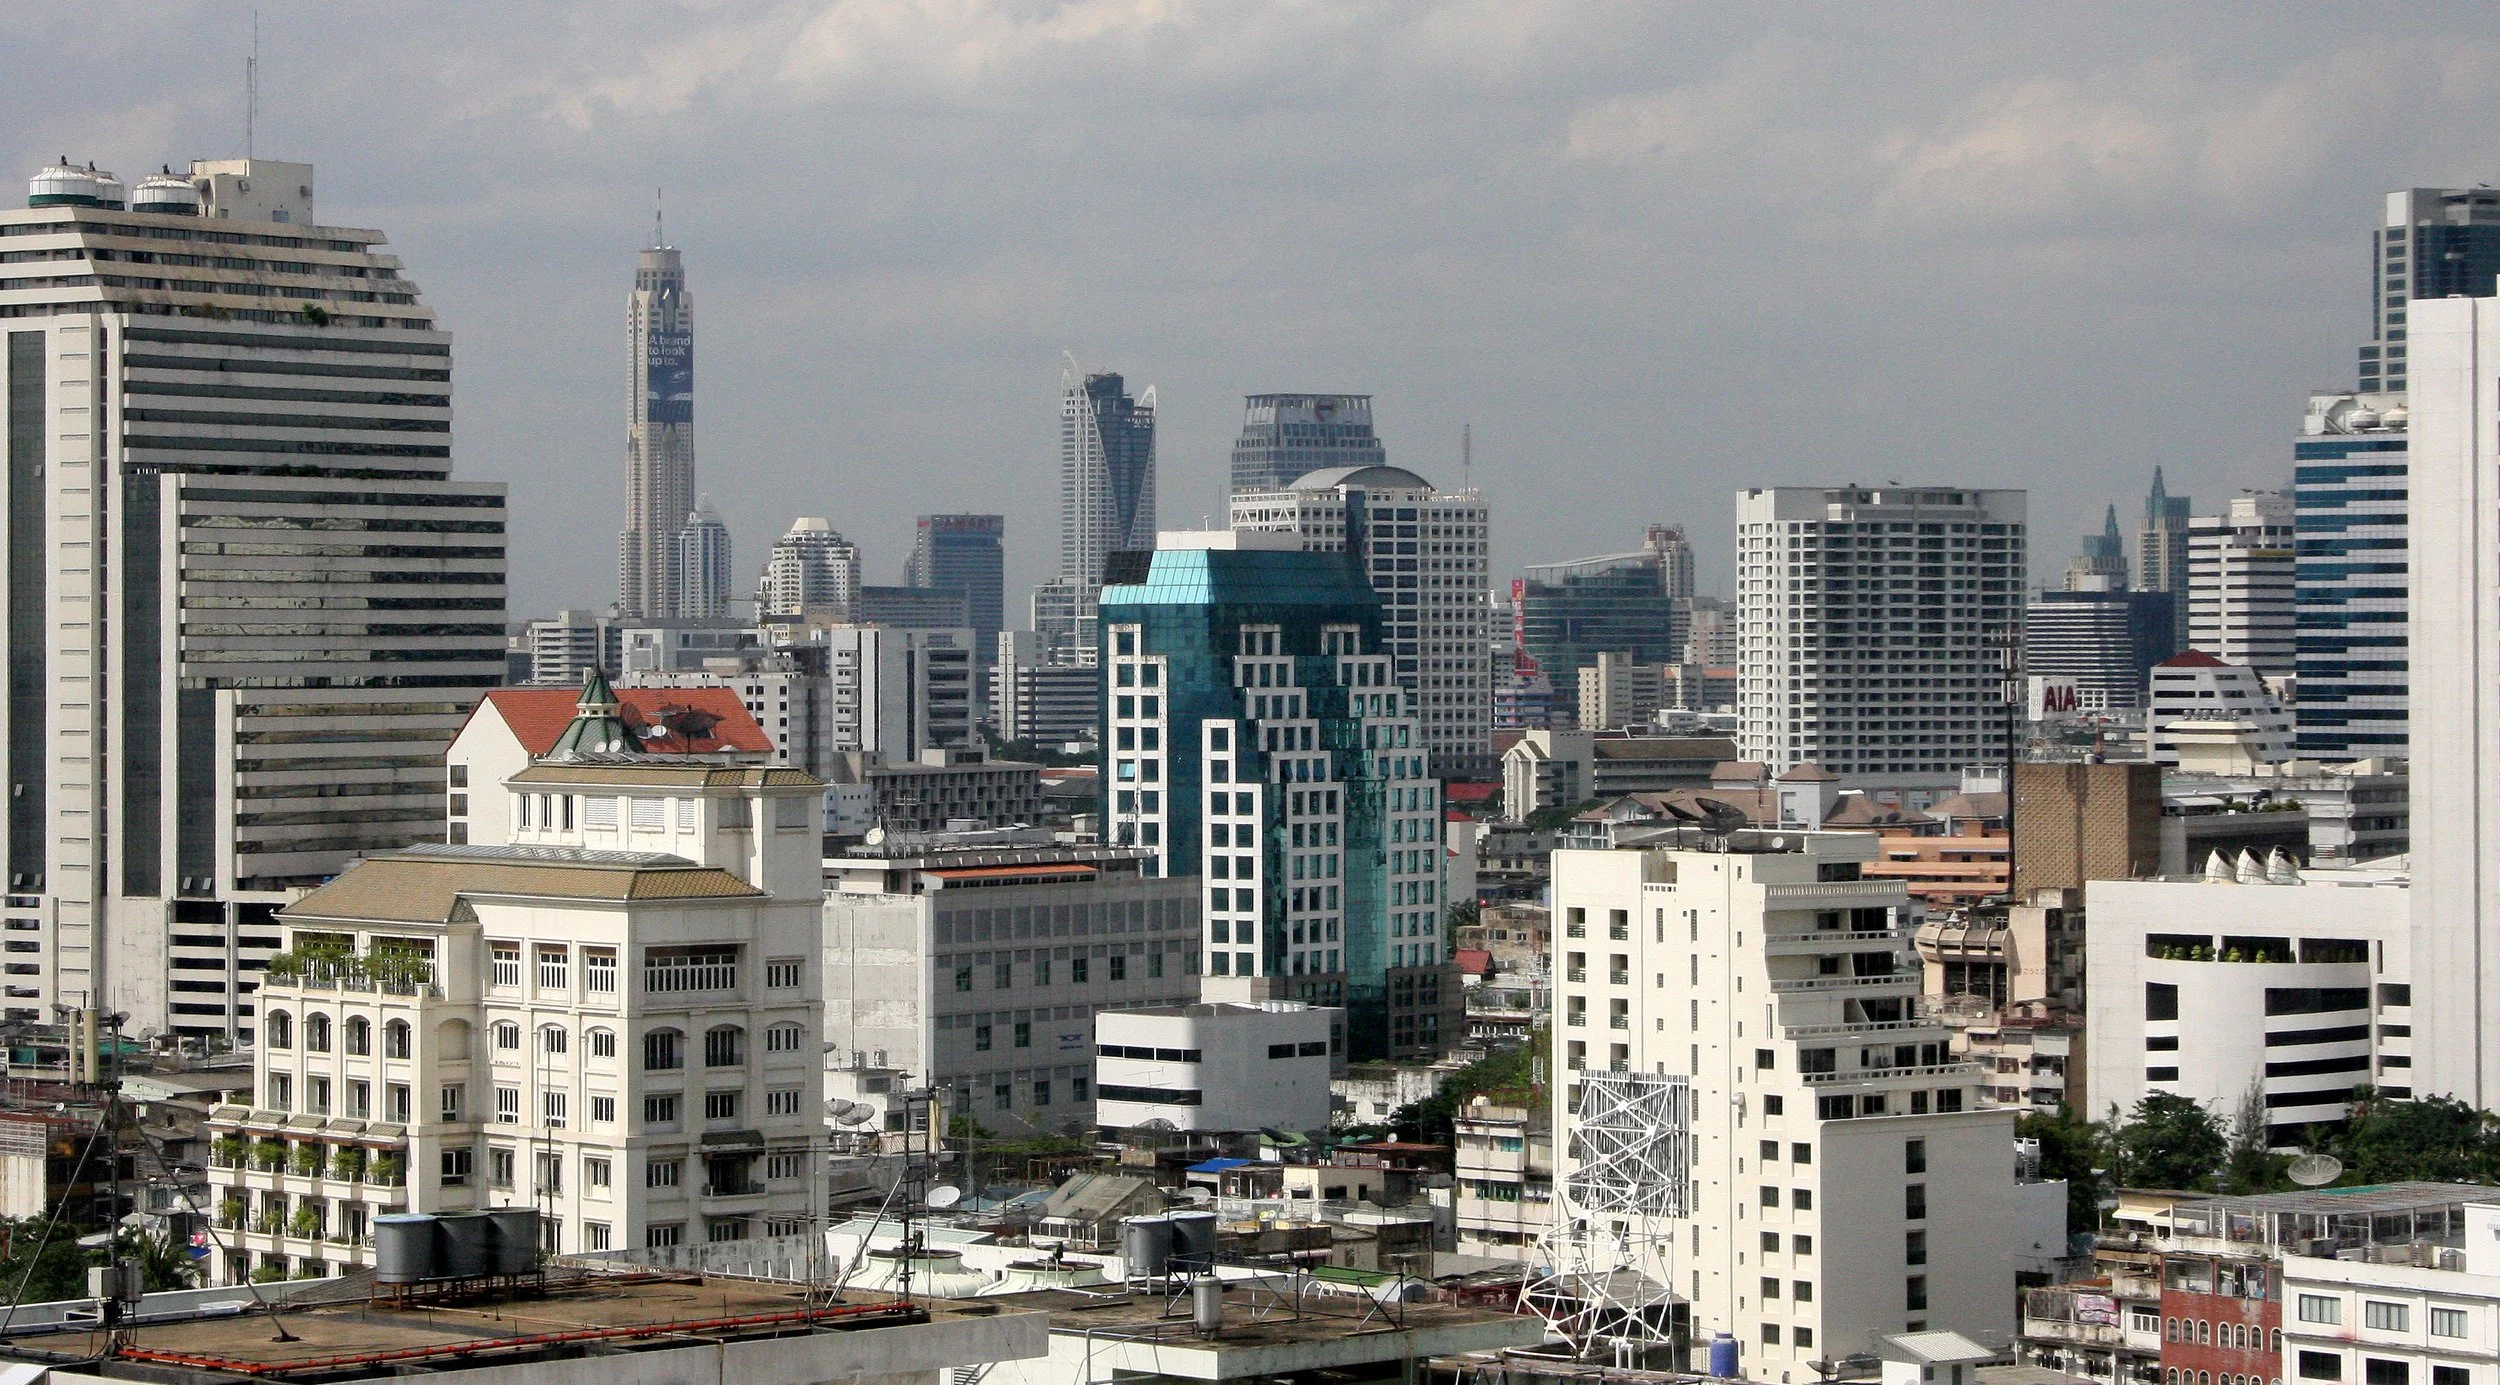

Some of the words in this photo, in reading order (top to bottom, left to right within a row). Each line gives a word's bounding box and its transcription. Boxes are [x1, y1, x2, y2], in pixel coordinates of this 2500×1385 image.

[648, 334, 658, 345] A
[659, 334, 691, 346] brand
[648, 345, 659, 355] to
[661, 345, 686, 356] look
[648, 357, 662, 367] up
[663, 357, 678, 366] to.
[802, 607, 846, 616] NOVOTEL
[2043, 685, 2077, 712] AIA
